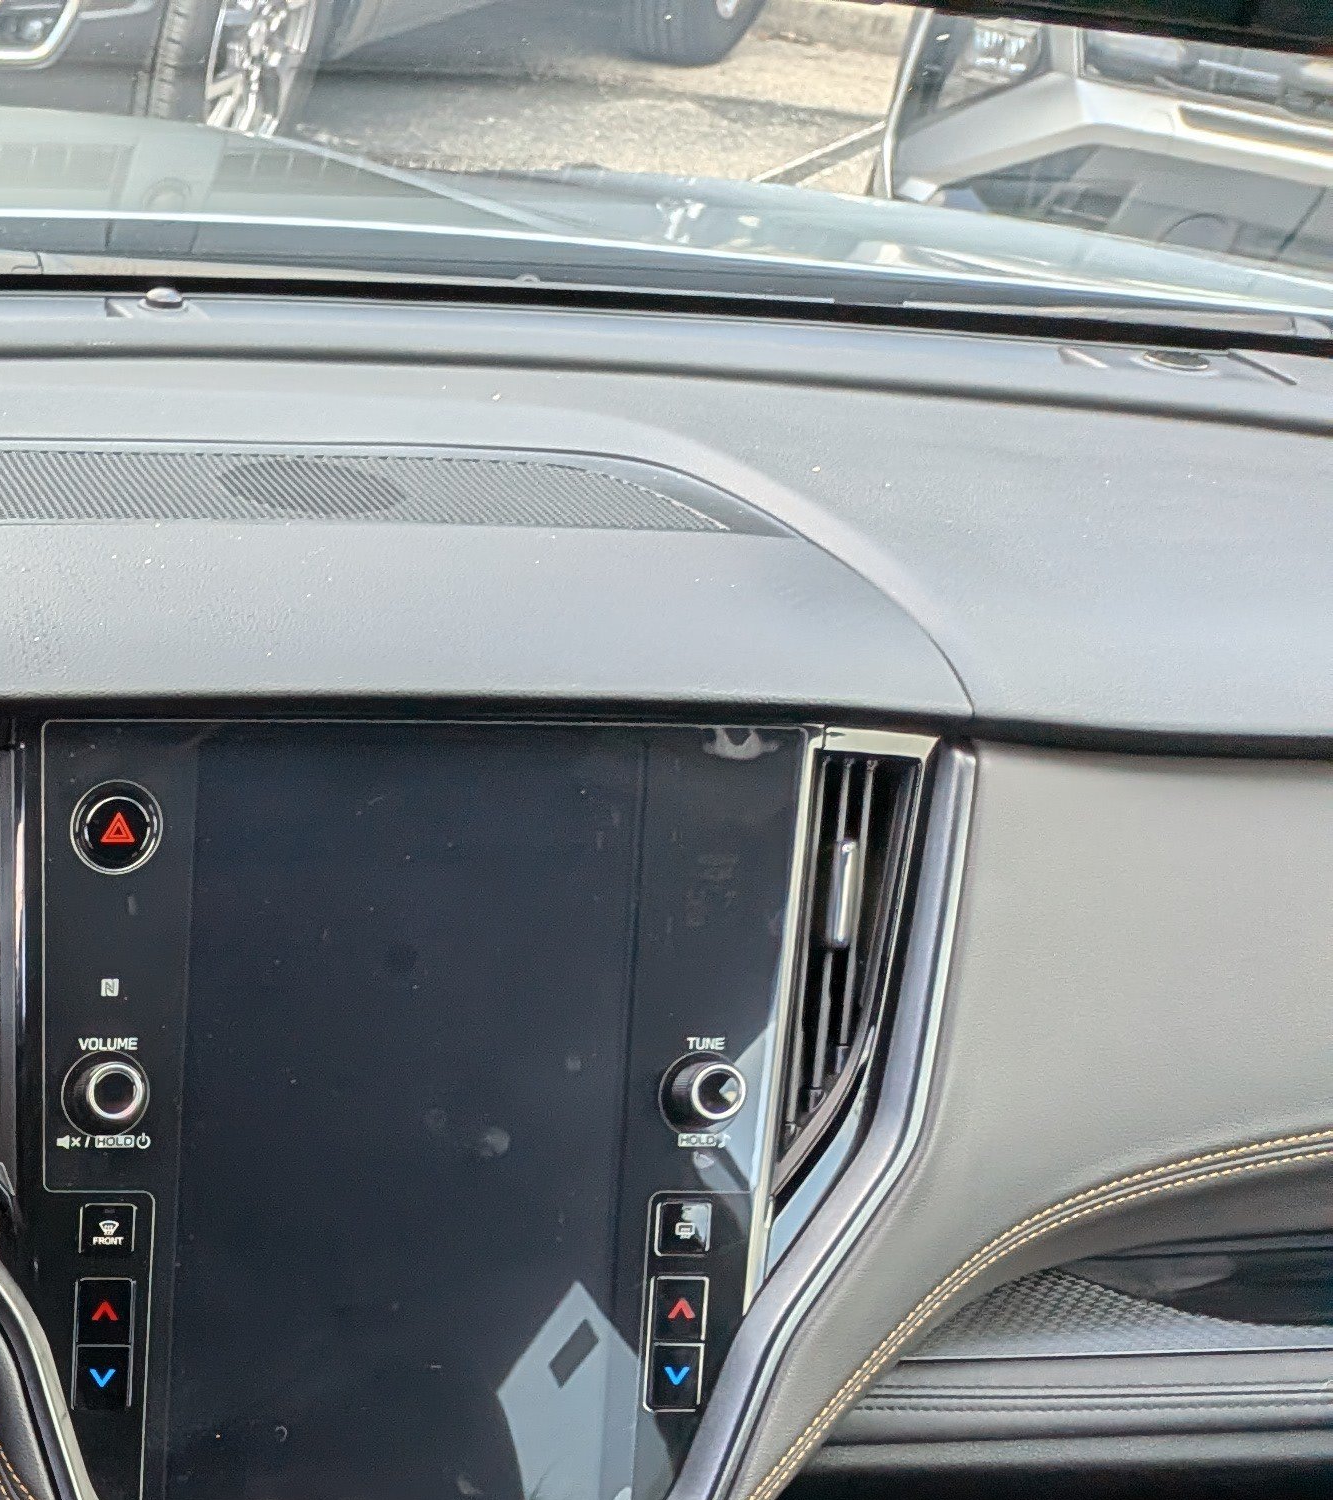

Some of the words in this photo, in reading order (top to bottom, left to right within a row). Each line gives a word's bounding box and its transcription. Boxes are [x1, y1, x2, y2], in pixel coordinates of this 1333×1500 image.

[78, 1037, 138, 1051] VOLUME
[686, 1037, 726, 1050] TUNE
[96, 1136, 134, 1147] HOLD
[678, 1134, 716, 1146] HOLD
[93, 1236, 124, 1245] FRONT
